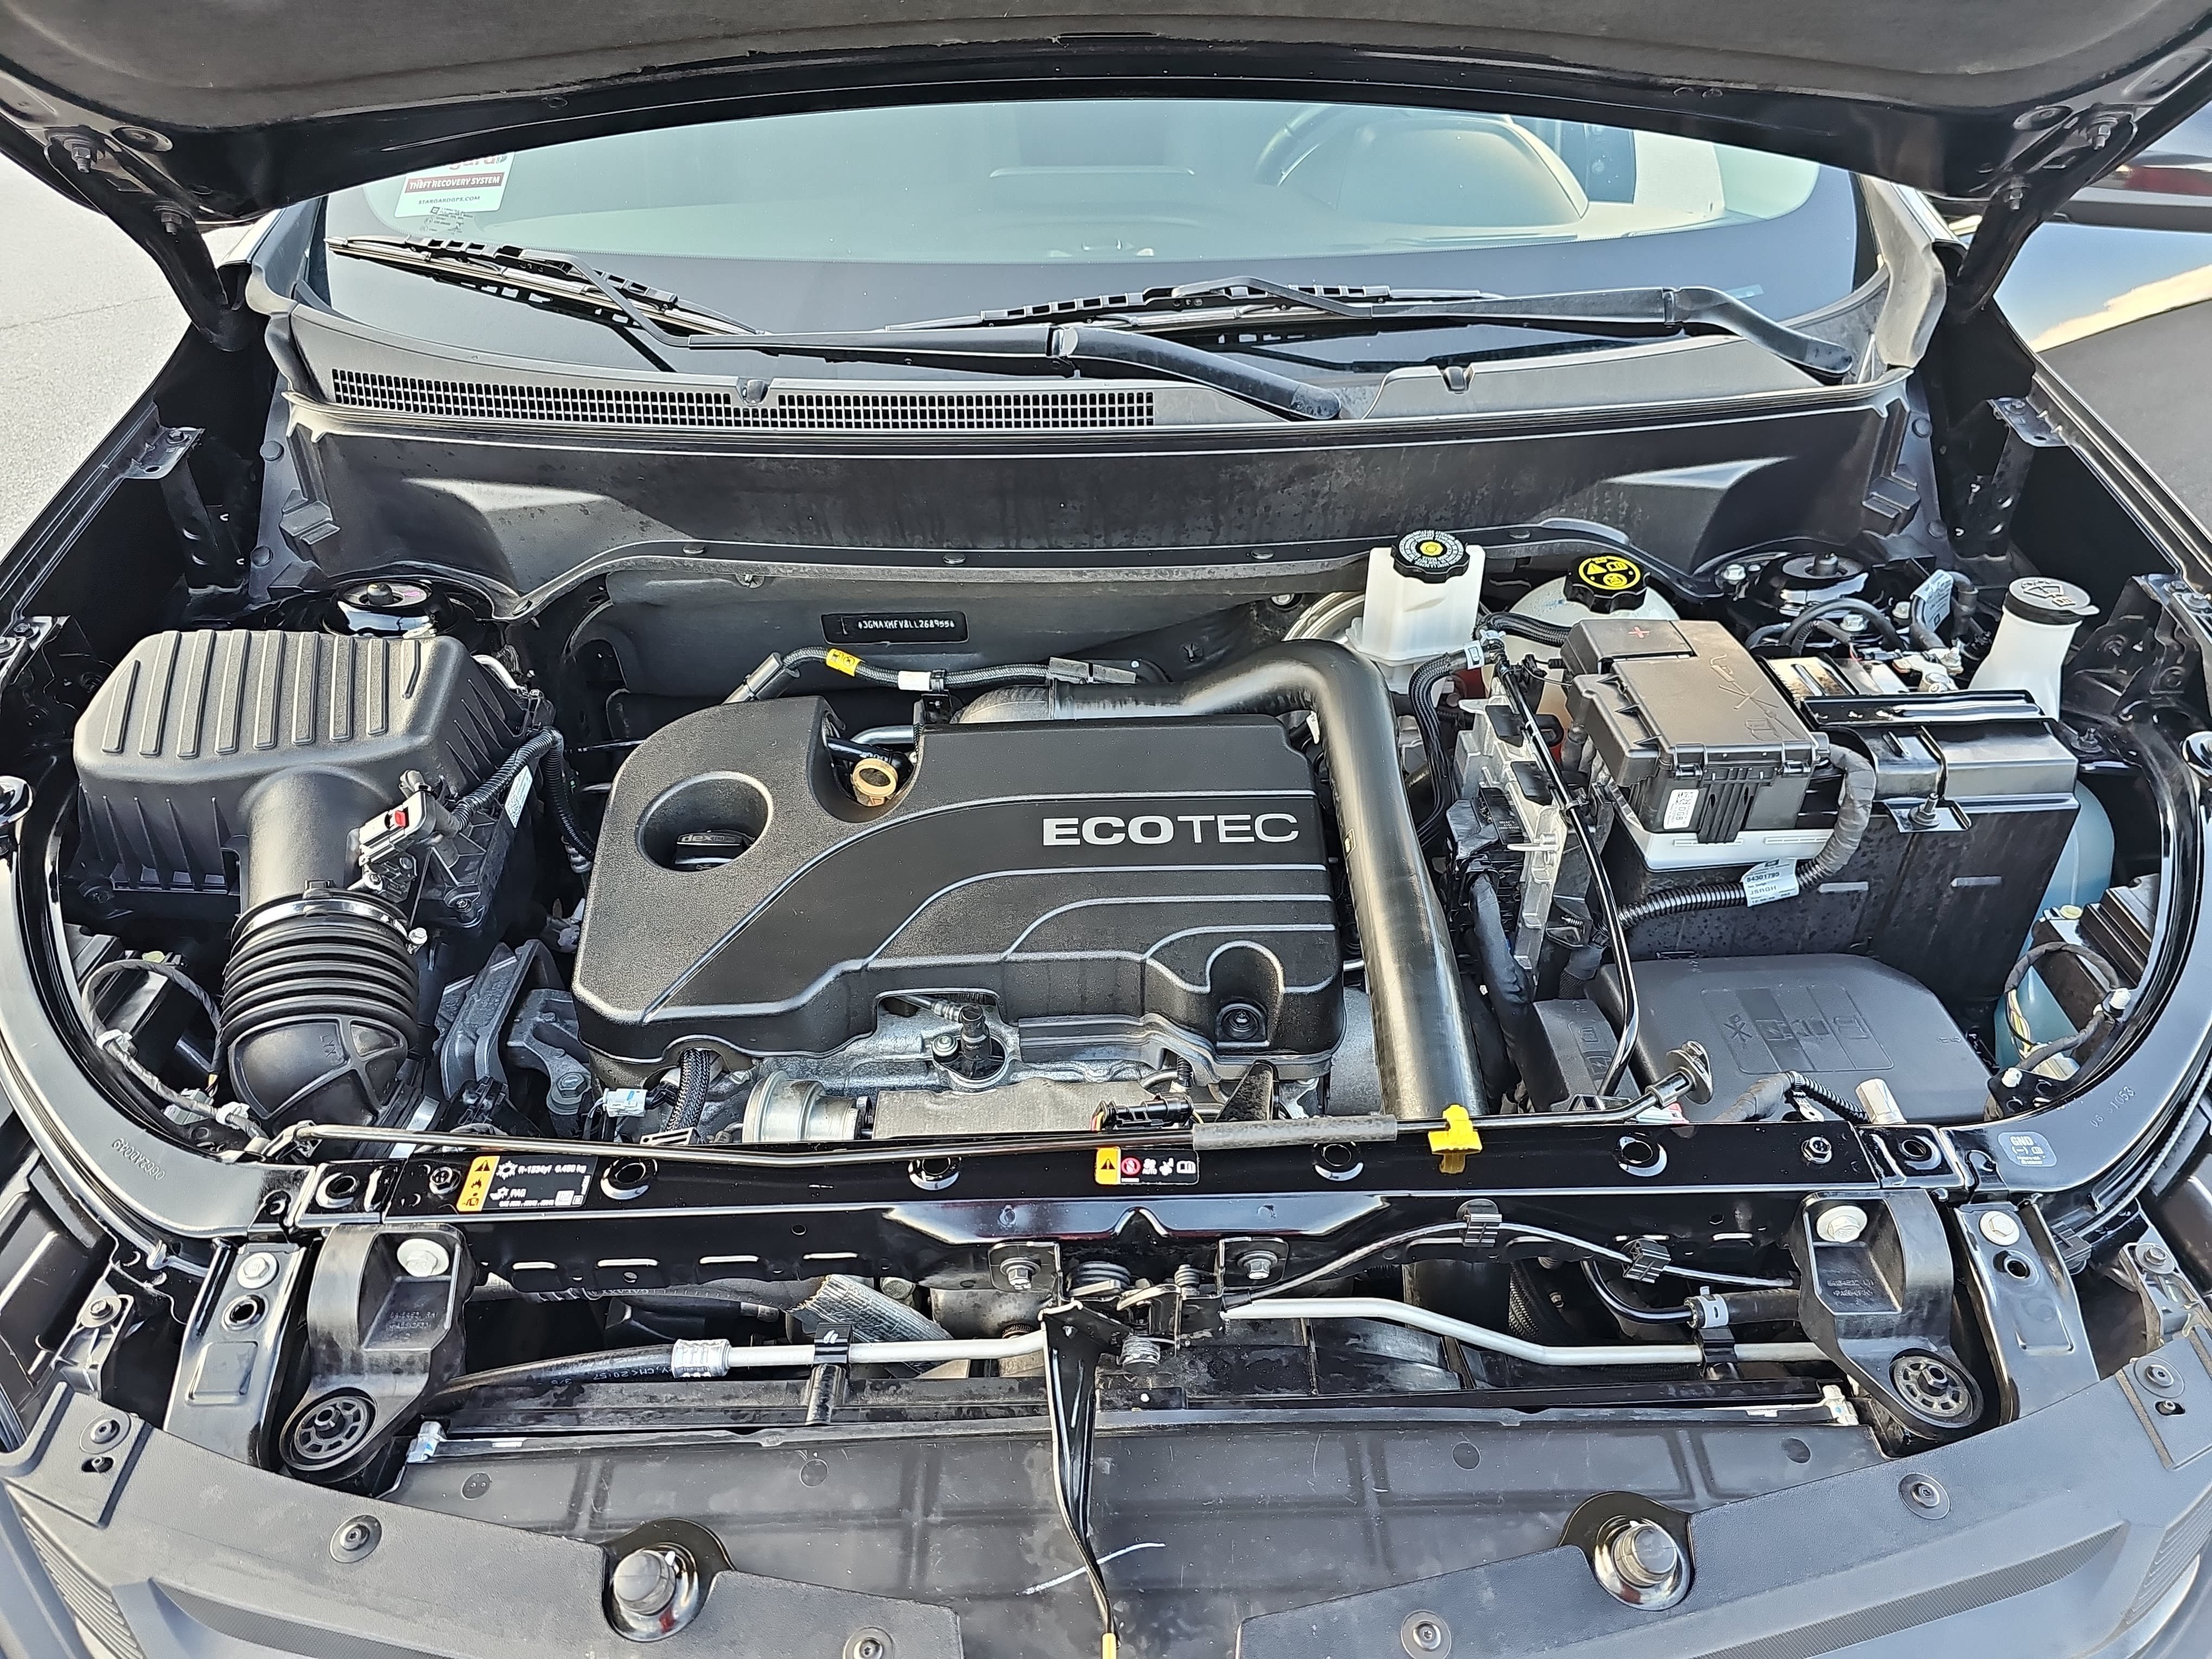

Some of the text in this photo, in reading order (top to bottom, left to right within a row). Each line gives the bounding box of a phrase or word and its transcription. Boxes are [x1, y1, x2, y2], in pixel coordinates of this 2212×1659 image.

[409, 176, 500, 190] THEFT RECOVERY SYSTEM
[1043, 813, 1299, 846] ECOTEC
[2010, 1136, 2034, 1146] GND
